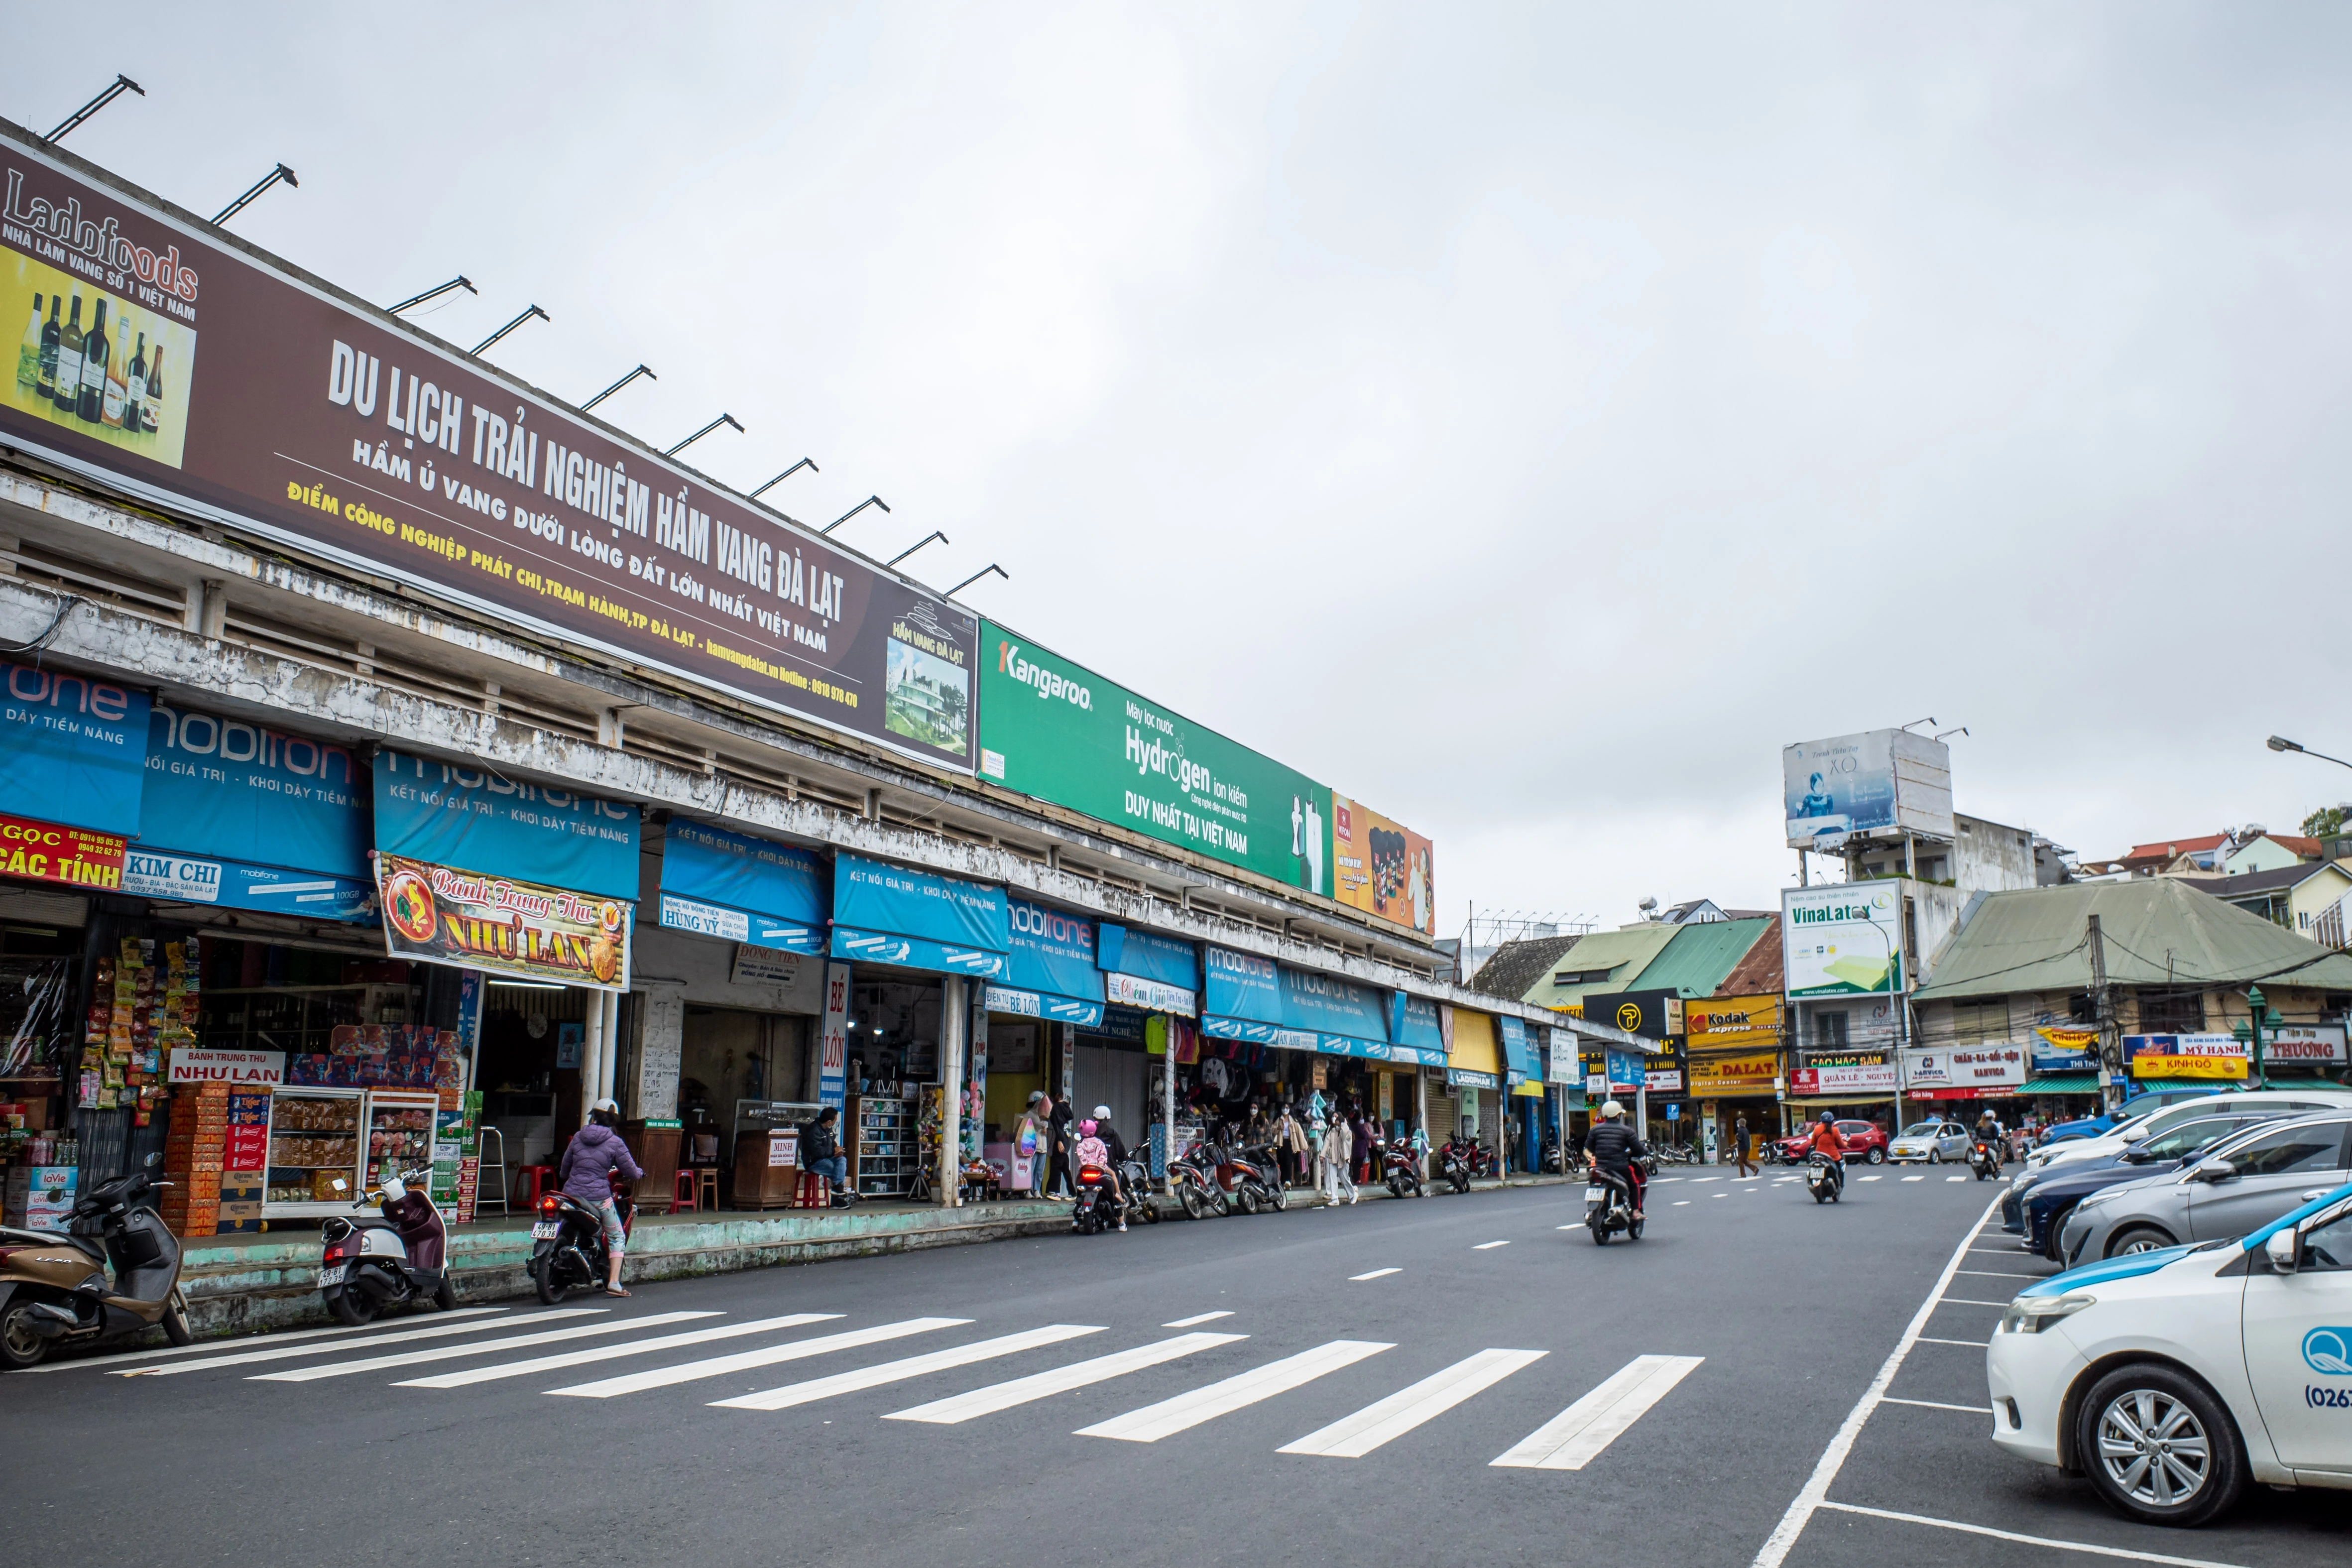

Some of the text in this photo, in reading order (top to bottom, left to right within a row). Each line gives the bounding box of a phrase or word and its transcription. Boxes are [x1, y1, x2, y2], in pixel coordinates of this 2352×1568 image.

[2, 167, 199, 302] Ladofoods
[2, 223, 196, 322] NHÀ LÀM VANG SỐ 1 VIỆT NAM
[329, 339, 843, 627] DU LỊCH TRẢI NGHIỆM HẦM VANG ĐÀ LẠT
[353, 439, 826, 653] HẦM Ủ VANG DƯỚI LÒNG ĐẤT LỚN NHẤT VIỆT NAM
[287, 482, 339, 515] ĐIỂM
[345, 503, 395, 535] CÔNG
[401, 523, 467, 562] NGHIỆP
[471, 550, 512, 580] PHÁT
[651, 617, 670, 639] ĐÀ
[673, 627, 695, 648] LẠT
[706, 638, 778, 680] hamvangdalat.vn
[779, 665, 807, 691] Hotline
[812, 679, 830, 701] 0918
[831, 686, 844, 704] 978
[845, 690, 858, 708] 470
[893, 621, 964, 666] HẦM VANG ĐÀ LẠT
[6, 708, 124, 745] DẬY TIỀM NĂNG
[1126, 700, 1174, 736] Máy lọc nước
[1126, 725, 1247, 809] Hydrogen ion kiềm
[1191, 793, 1202, 808] Công
[389, 783, 416, 801] KẾT
[421, 791, 444, 807] NỐI
[448, 793, 469, 811] GIÁ
[473, 801, 493, 817] TRỊ
[511, 808, 538, 826] KHƠI
[543, 816, 566, 832] DẬY
[600, 827, 629, 844] NĂNG
[1126, 790, 1247, 855] DUY NHẤT TẠI VIỆT NAM
[0, 823, 123, 847] GỌC ĐT: 0914 95 05 32
[1338, 824, 1351, 839] VIFON
[78, 843, 121, 857] 0949 32 62 79
[57, 853, 120, 889] TỈNH
[127, 855, 218, 884] KIM CHI
[240, 869, 279, 880] mobifone
[124, 875, 144, 886] RƯỢU
[166, 881, 179, 890] ĐẶC
[205, 886, 217, 895] LẠT
[336, 890, 359, 900] 100GB
[431, 868, 491, 911] Bánh
[492, 879, 553, 921] Trung
[555, 892, 596, 924] Thu
[665, 909, 719, 934] HÙNG VỸ
[757, 919, 778, 928] mobifone
[440, 911, 592, 972] NHƯ LAN
[830, 973, 844, 1013] BÉ
[987, 990, 1039, 1016] ĐIỆN BÉ LỚN
[1708, 1011, 1750, 1026] Kodak
[188, 1049, 266, 1063] BÁNH TRUNG THU
[823, 1027, 844, 1068] LỚN
[2207, 1045, 2242, 1057] HẠNH
[2270, 1040, 2335, 1057] THƯƠNG
[174, 1066, 279, 1082] NHƯ LAN
[1722, 1063, 1774, 1076] DALAT
[1811, 1058, 1832, 1068] CAO
[1974, 1068, 2005, 1077] HANVICO
[2167, 1058, 2212, 1069] KINH ĐÔ
[241, 1097, 261, 1109] Tiger
[239, 1112, 260, 1124] Tiger
[774, 1142, 793, 1151] MINH
[320, 1274, 343, 1287] 172.35
